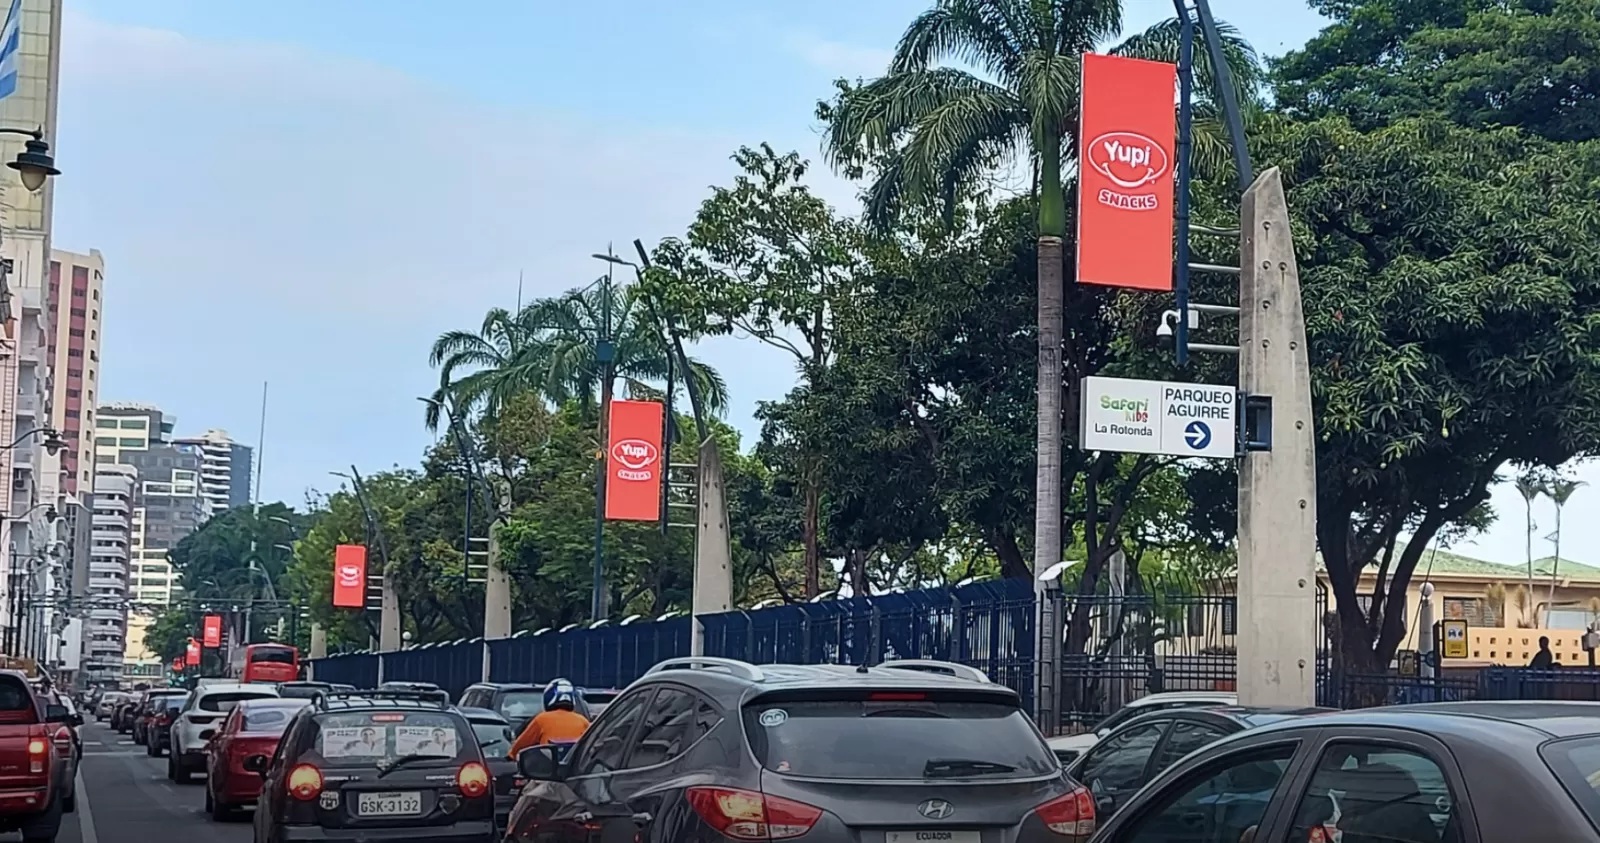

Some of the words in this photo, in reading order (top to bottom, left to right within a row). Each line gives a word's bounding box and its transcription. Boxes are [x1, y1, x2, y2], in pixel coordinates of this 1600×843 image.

[1104, 140, 1151, 168] Yupi
[1100, 190, 1157, 209] SNACKS
[1100, 395, 1149, 412] Safari
[1165, 388, 1233, 404] PARQUEO
[1167, 403, 1230, 420] AGUIRRE
[1094, 422, 1108, 433] La
[1110, 424, 1153, 436] Rotonda
[621, 443, 648, 458] Yupi
[360, 800, 419, 813] GSK-3132
[915, 831, 953, 841] ECUADOR
